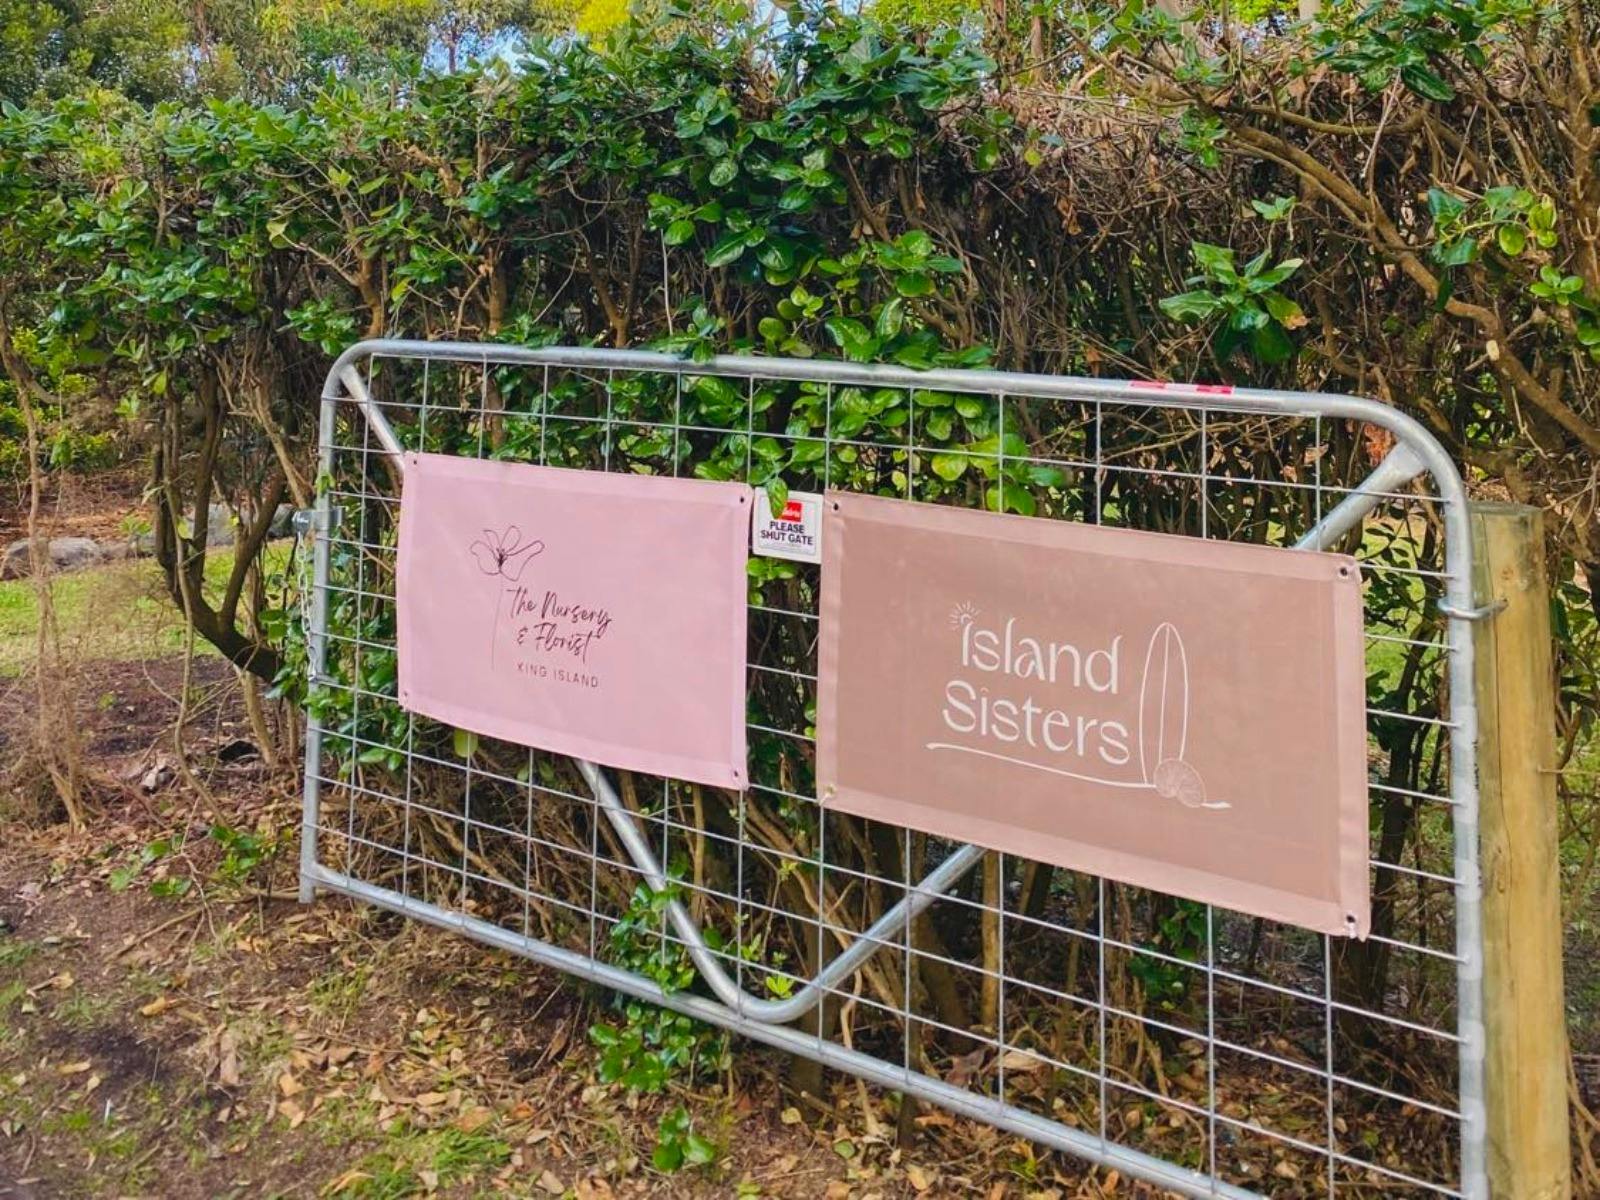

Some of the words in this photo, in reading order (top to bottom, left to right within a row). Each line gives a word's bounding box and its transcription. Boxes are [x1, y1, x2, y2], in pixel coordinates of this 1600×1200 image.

[761, 530, 786, 541] SHUT
[788, 534, 813, 545] GATE
[770, 521, 804, 534] PLEASE
[541, 591, 612, 639] Nursery
[516, 627, 528, 645] &
[533, 622, 594, 664] Florist
[517, 662, 548, 678] KING
[553, 670, 599, 688] ISLAND
[942, 680, 1130, 765] Sisters
